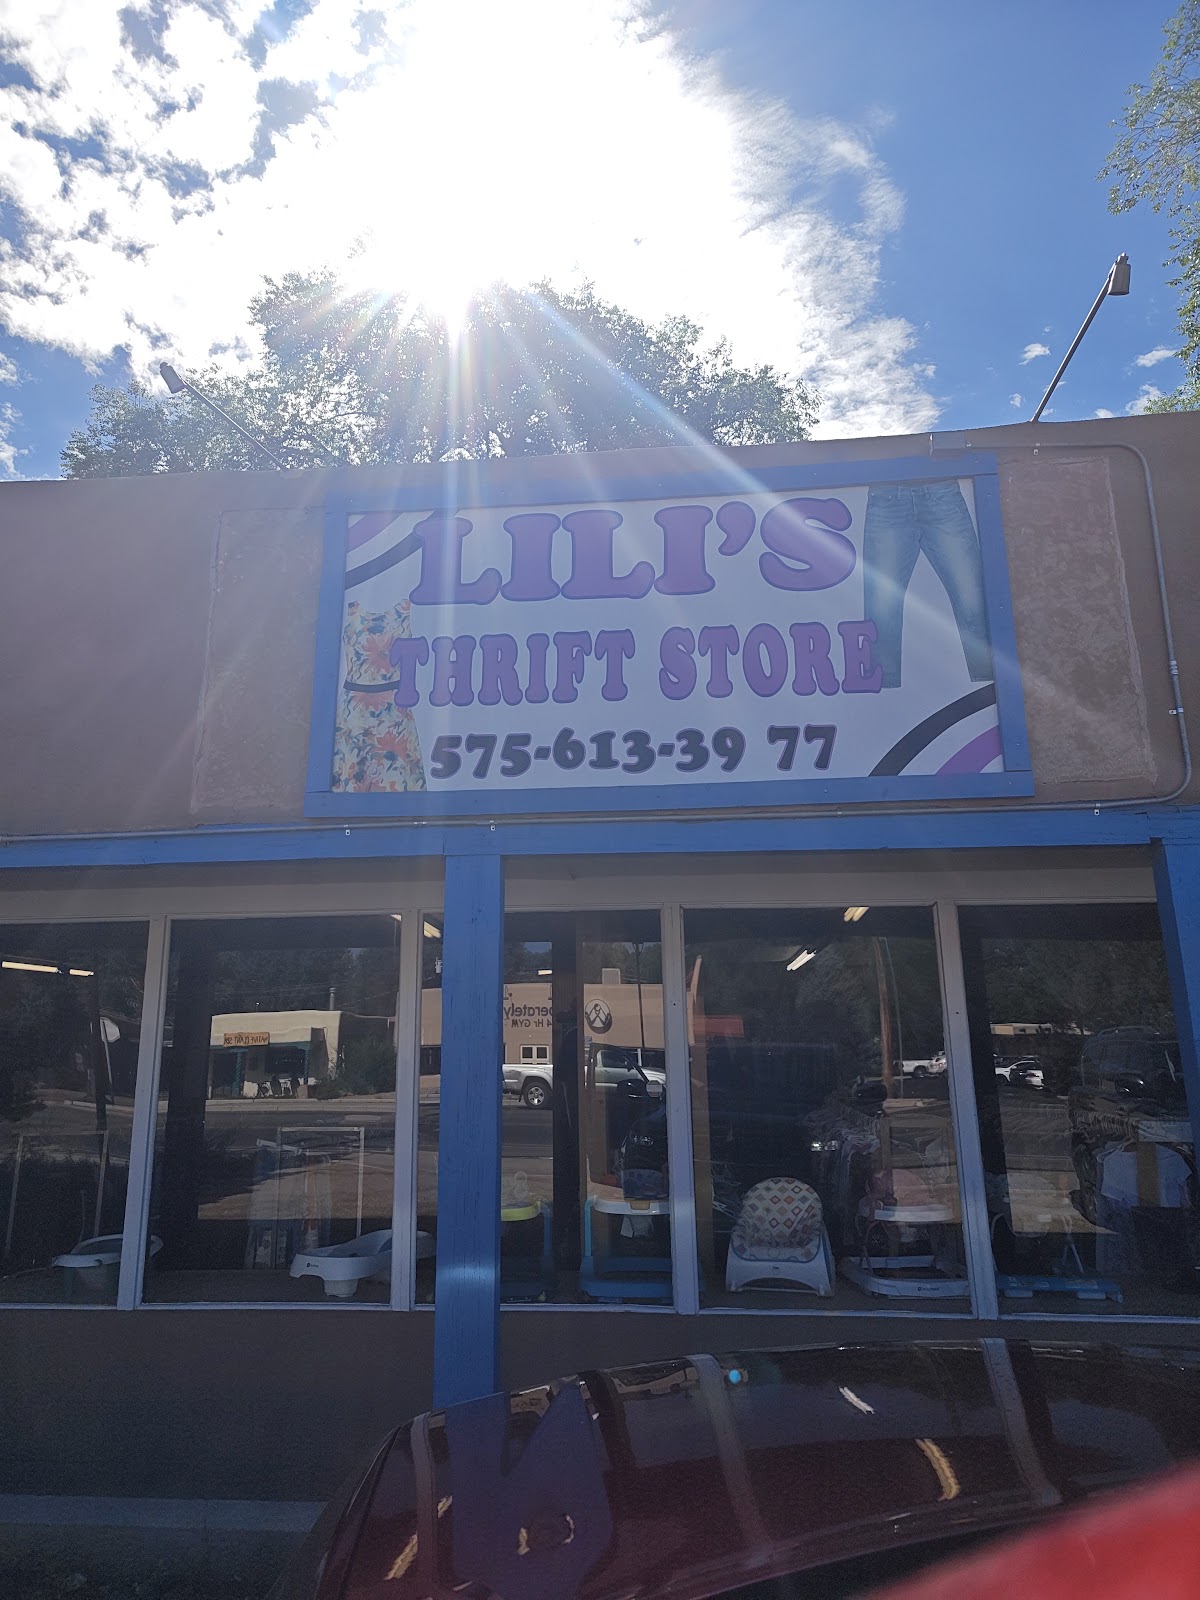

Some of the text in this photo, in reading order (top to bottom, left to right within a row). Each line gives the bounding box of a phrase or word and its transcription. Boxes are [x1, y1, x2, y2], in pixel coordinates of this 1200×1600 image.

[409, 498, 857, 605] LILI'S
[391, 620, 883, 708] THRIFT STORE
[429, 724, 838, 780] 575-613-39 77
